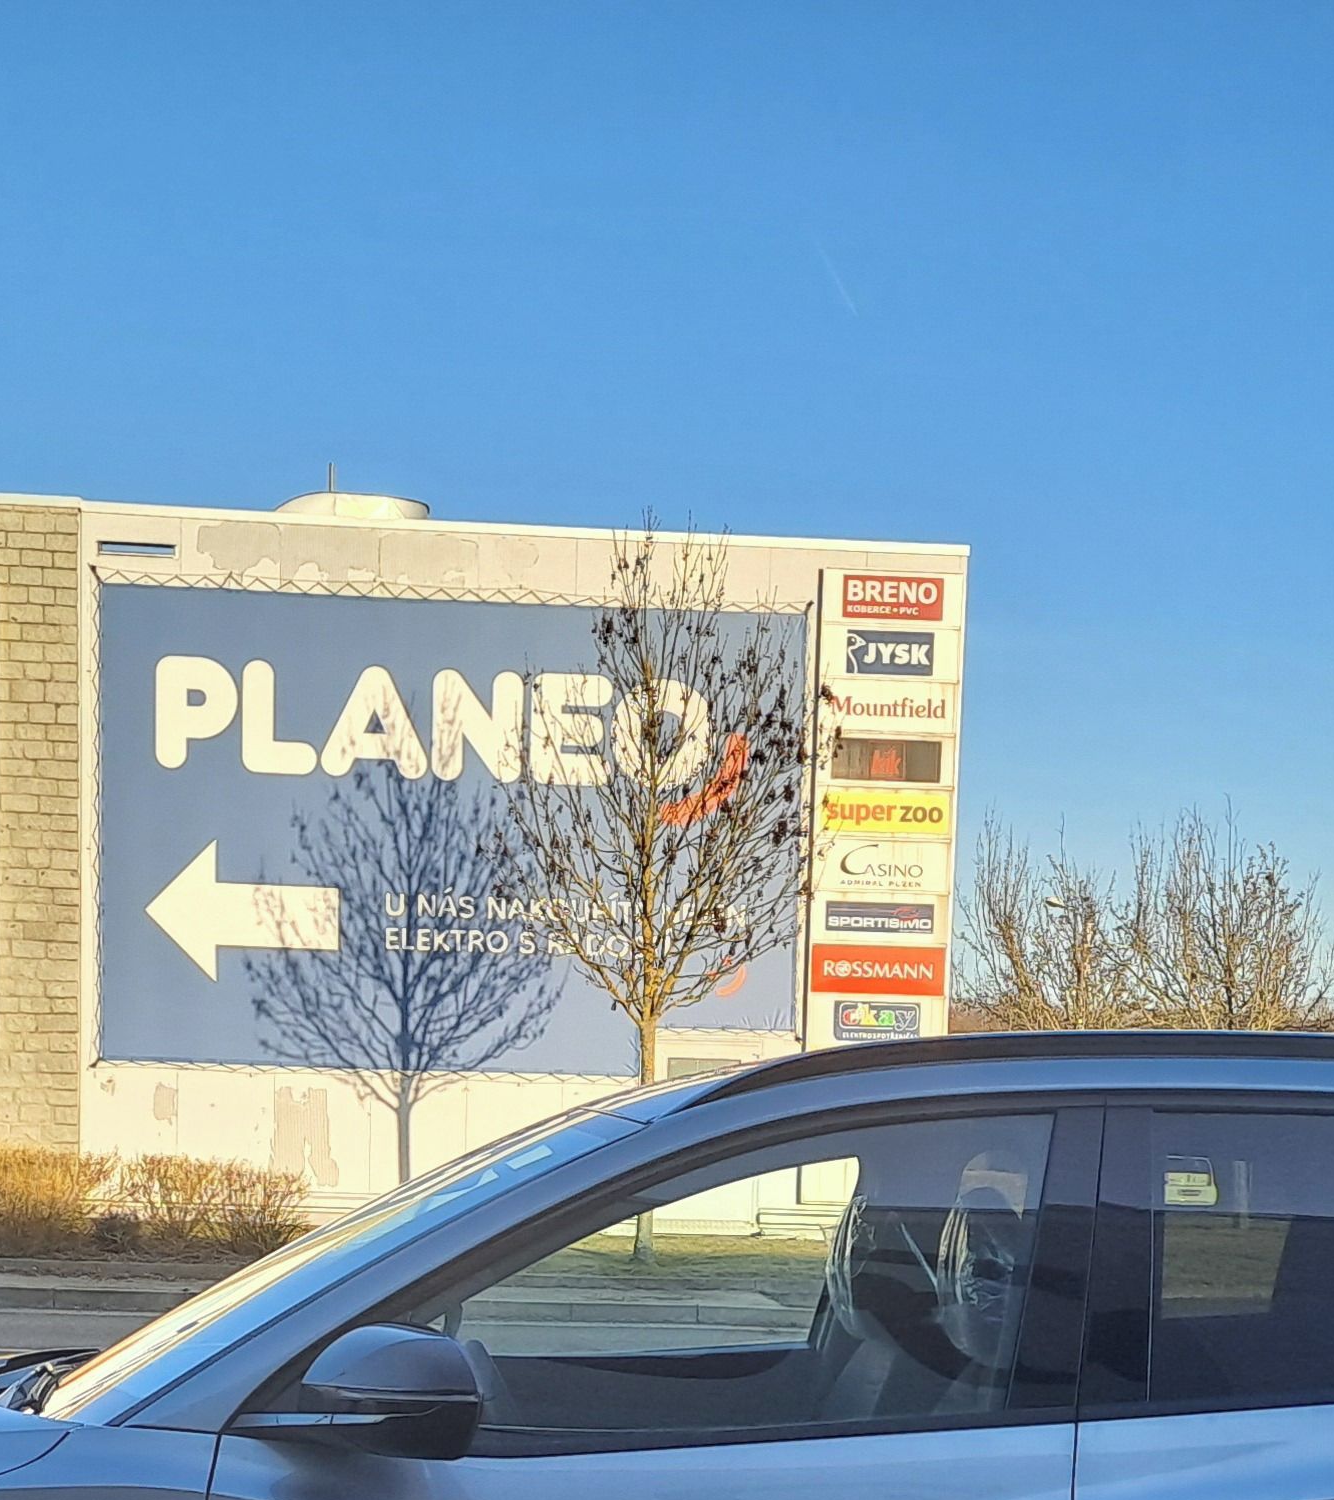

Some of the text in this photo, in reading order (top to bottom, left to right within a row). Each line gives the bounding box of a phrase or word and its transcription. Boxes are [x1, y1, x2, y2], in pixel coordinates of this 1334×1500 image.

[847, 579, 938, 605] BRENO
[846, 604, 919, 616] KOBERCE PVC
[863, 642, 931, 665] JYSK
[830, 695, 946, 719] Mountfield
[154, 655, 711, 790] PLANEO
[839, 844, 924, 878] CASINO
[384, 892, 405, 917] U
[416, 887, 476, 920] NÁS
[827, 915, 932, 930] SPORTISIMO
[384, 927, 509, 954] ELEKTRO
[519, 930, 537, 955] S
[823, 959, 934, 980] ROSSMANN
